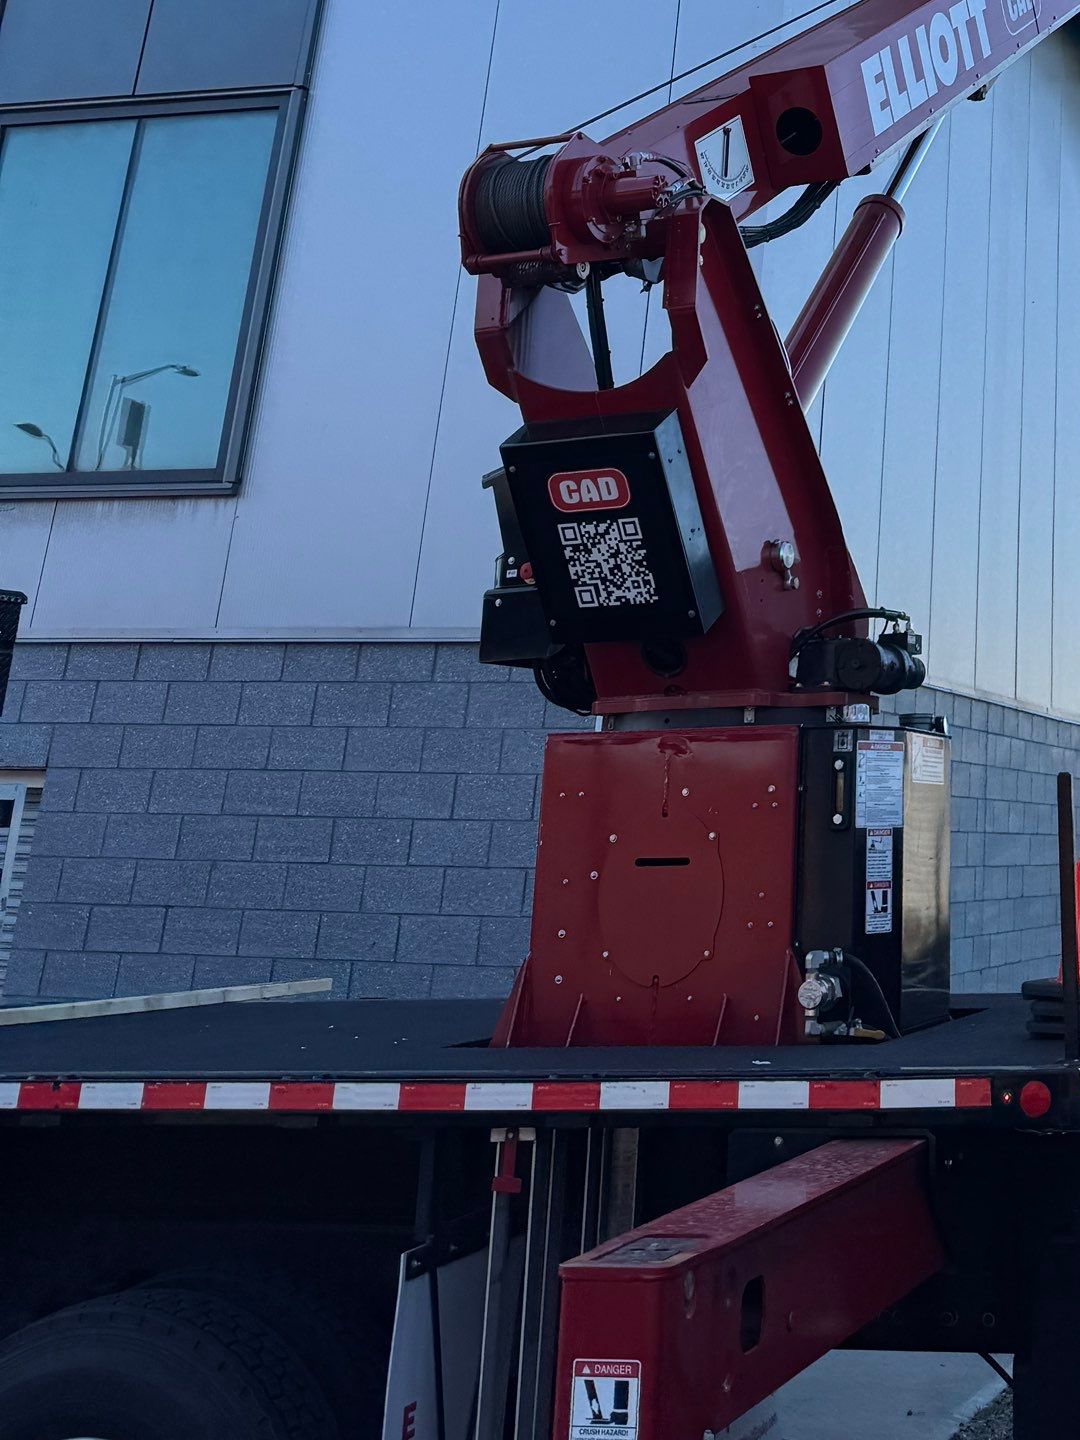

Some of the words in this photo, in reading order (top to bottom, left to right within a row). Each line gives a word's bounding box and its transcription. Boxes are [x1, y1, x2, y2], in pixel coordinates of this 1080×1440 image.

[558, 476, 620, 505] CAD
[594, 1364, 632, 1375] DANGER
[579, 1428, 600, 1436] CRUSH
[600, 1429, 629, 1437] HAZARD!
